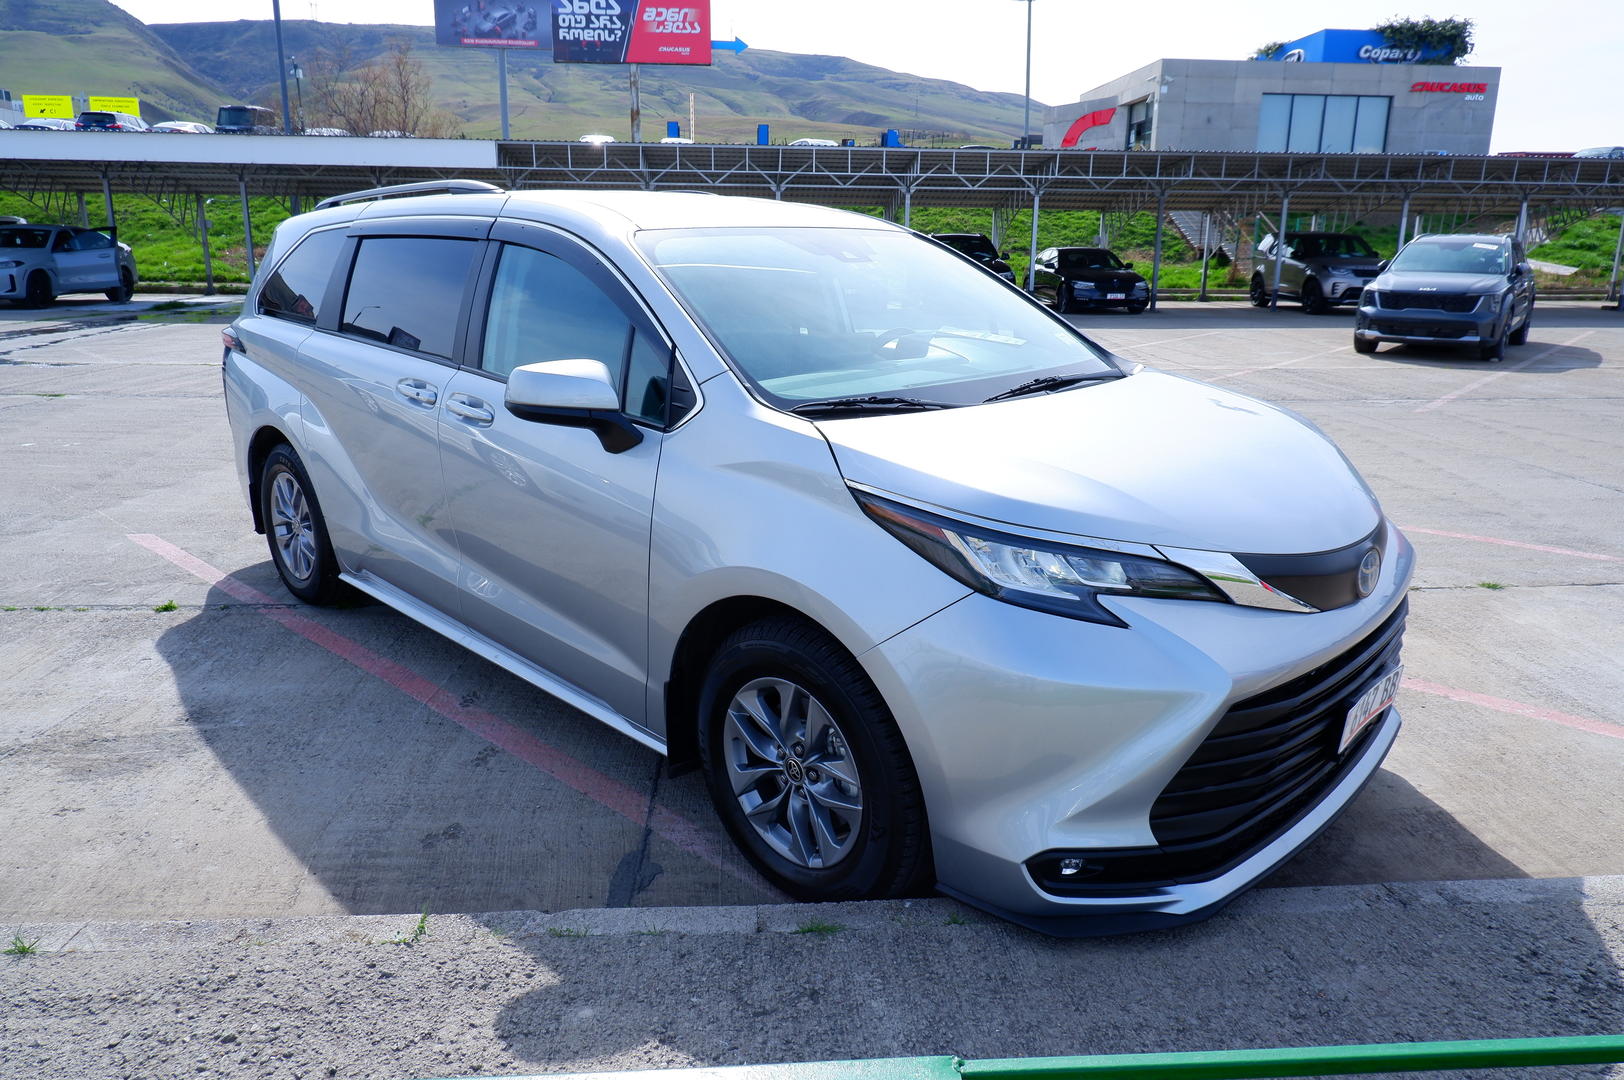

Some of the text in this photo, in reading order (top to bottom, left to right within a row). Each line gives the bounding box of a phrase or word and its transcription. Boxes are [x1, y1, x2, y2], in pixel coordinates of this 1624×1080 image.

[558, 15, 586, 28] თუ
[559, 29, 622, 41] როდის?
[1409, 82, 1488, 93] CAUCASUS
